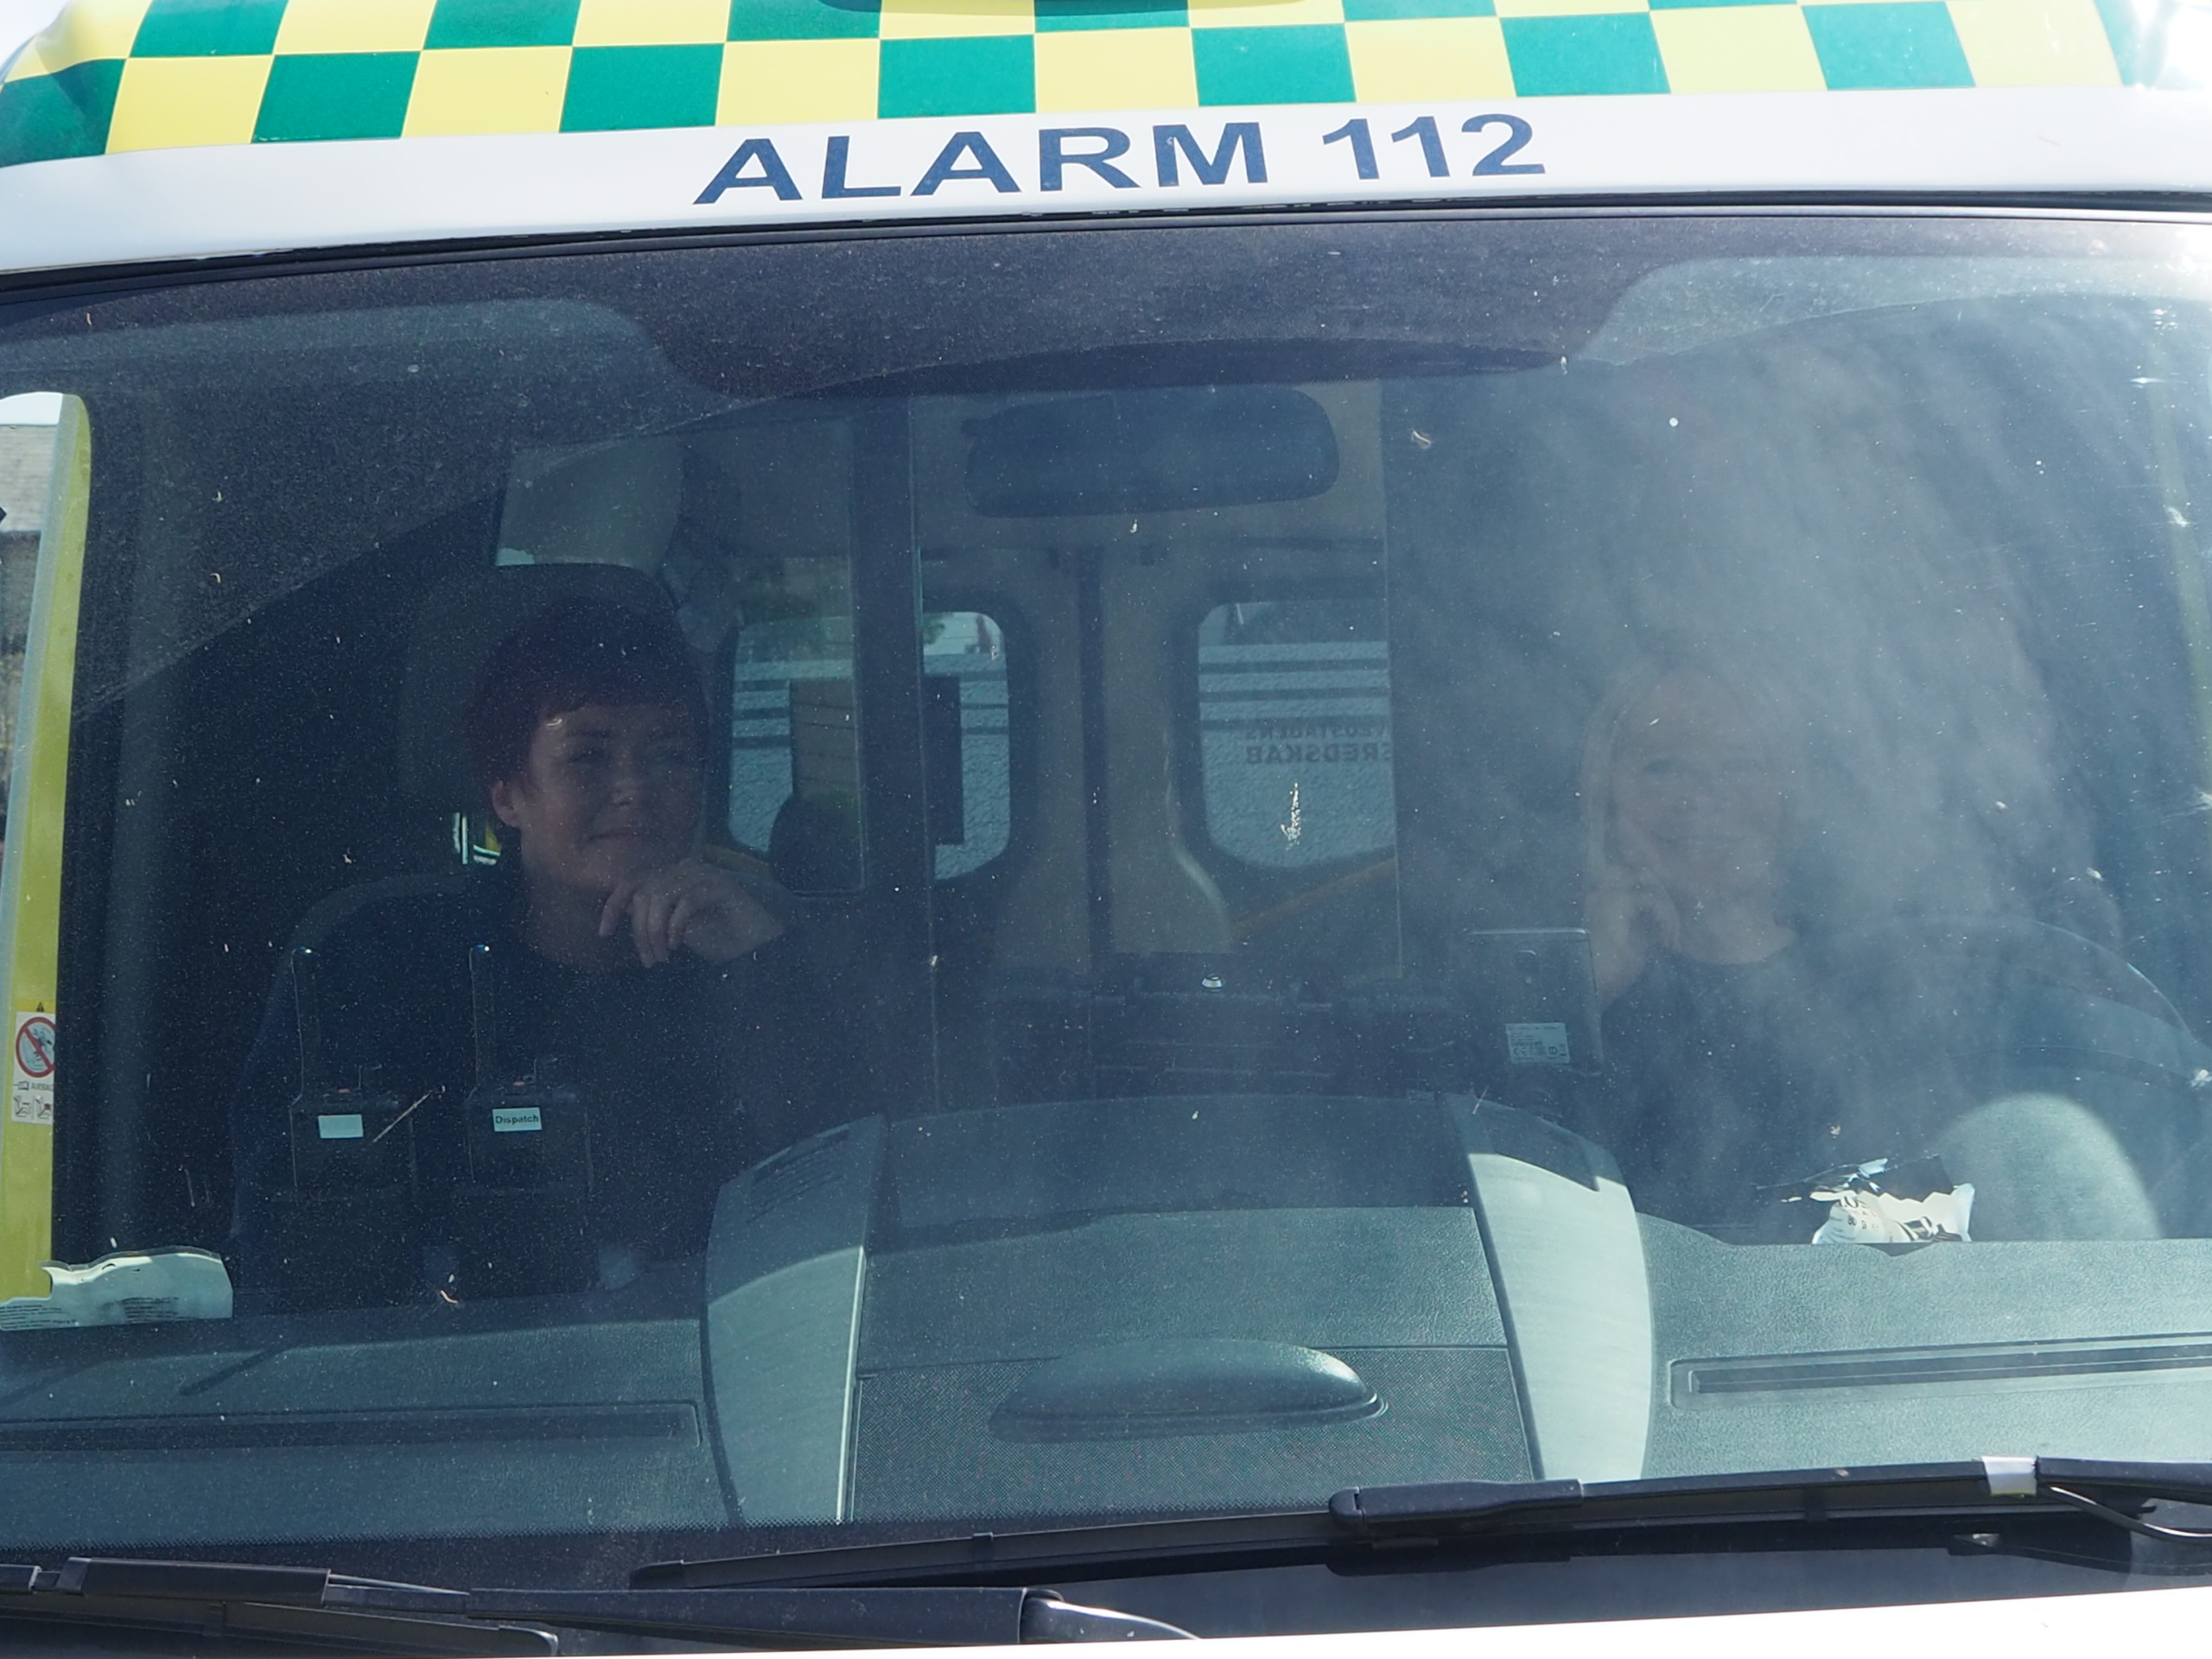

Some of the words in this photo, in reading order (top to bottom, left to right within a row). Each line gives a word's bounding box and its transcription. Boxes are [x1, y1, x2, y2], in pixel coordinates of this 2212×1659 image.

[693, 122, 1268, 204] ALARM
[1323, 114, 1546, 180] 112
[495, 1115, 539, 1125] Dispatch
